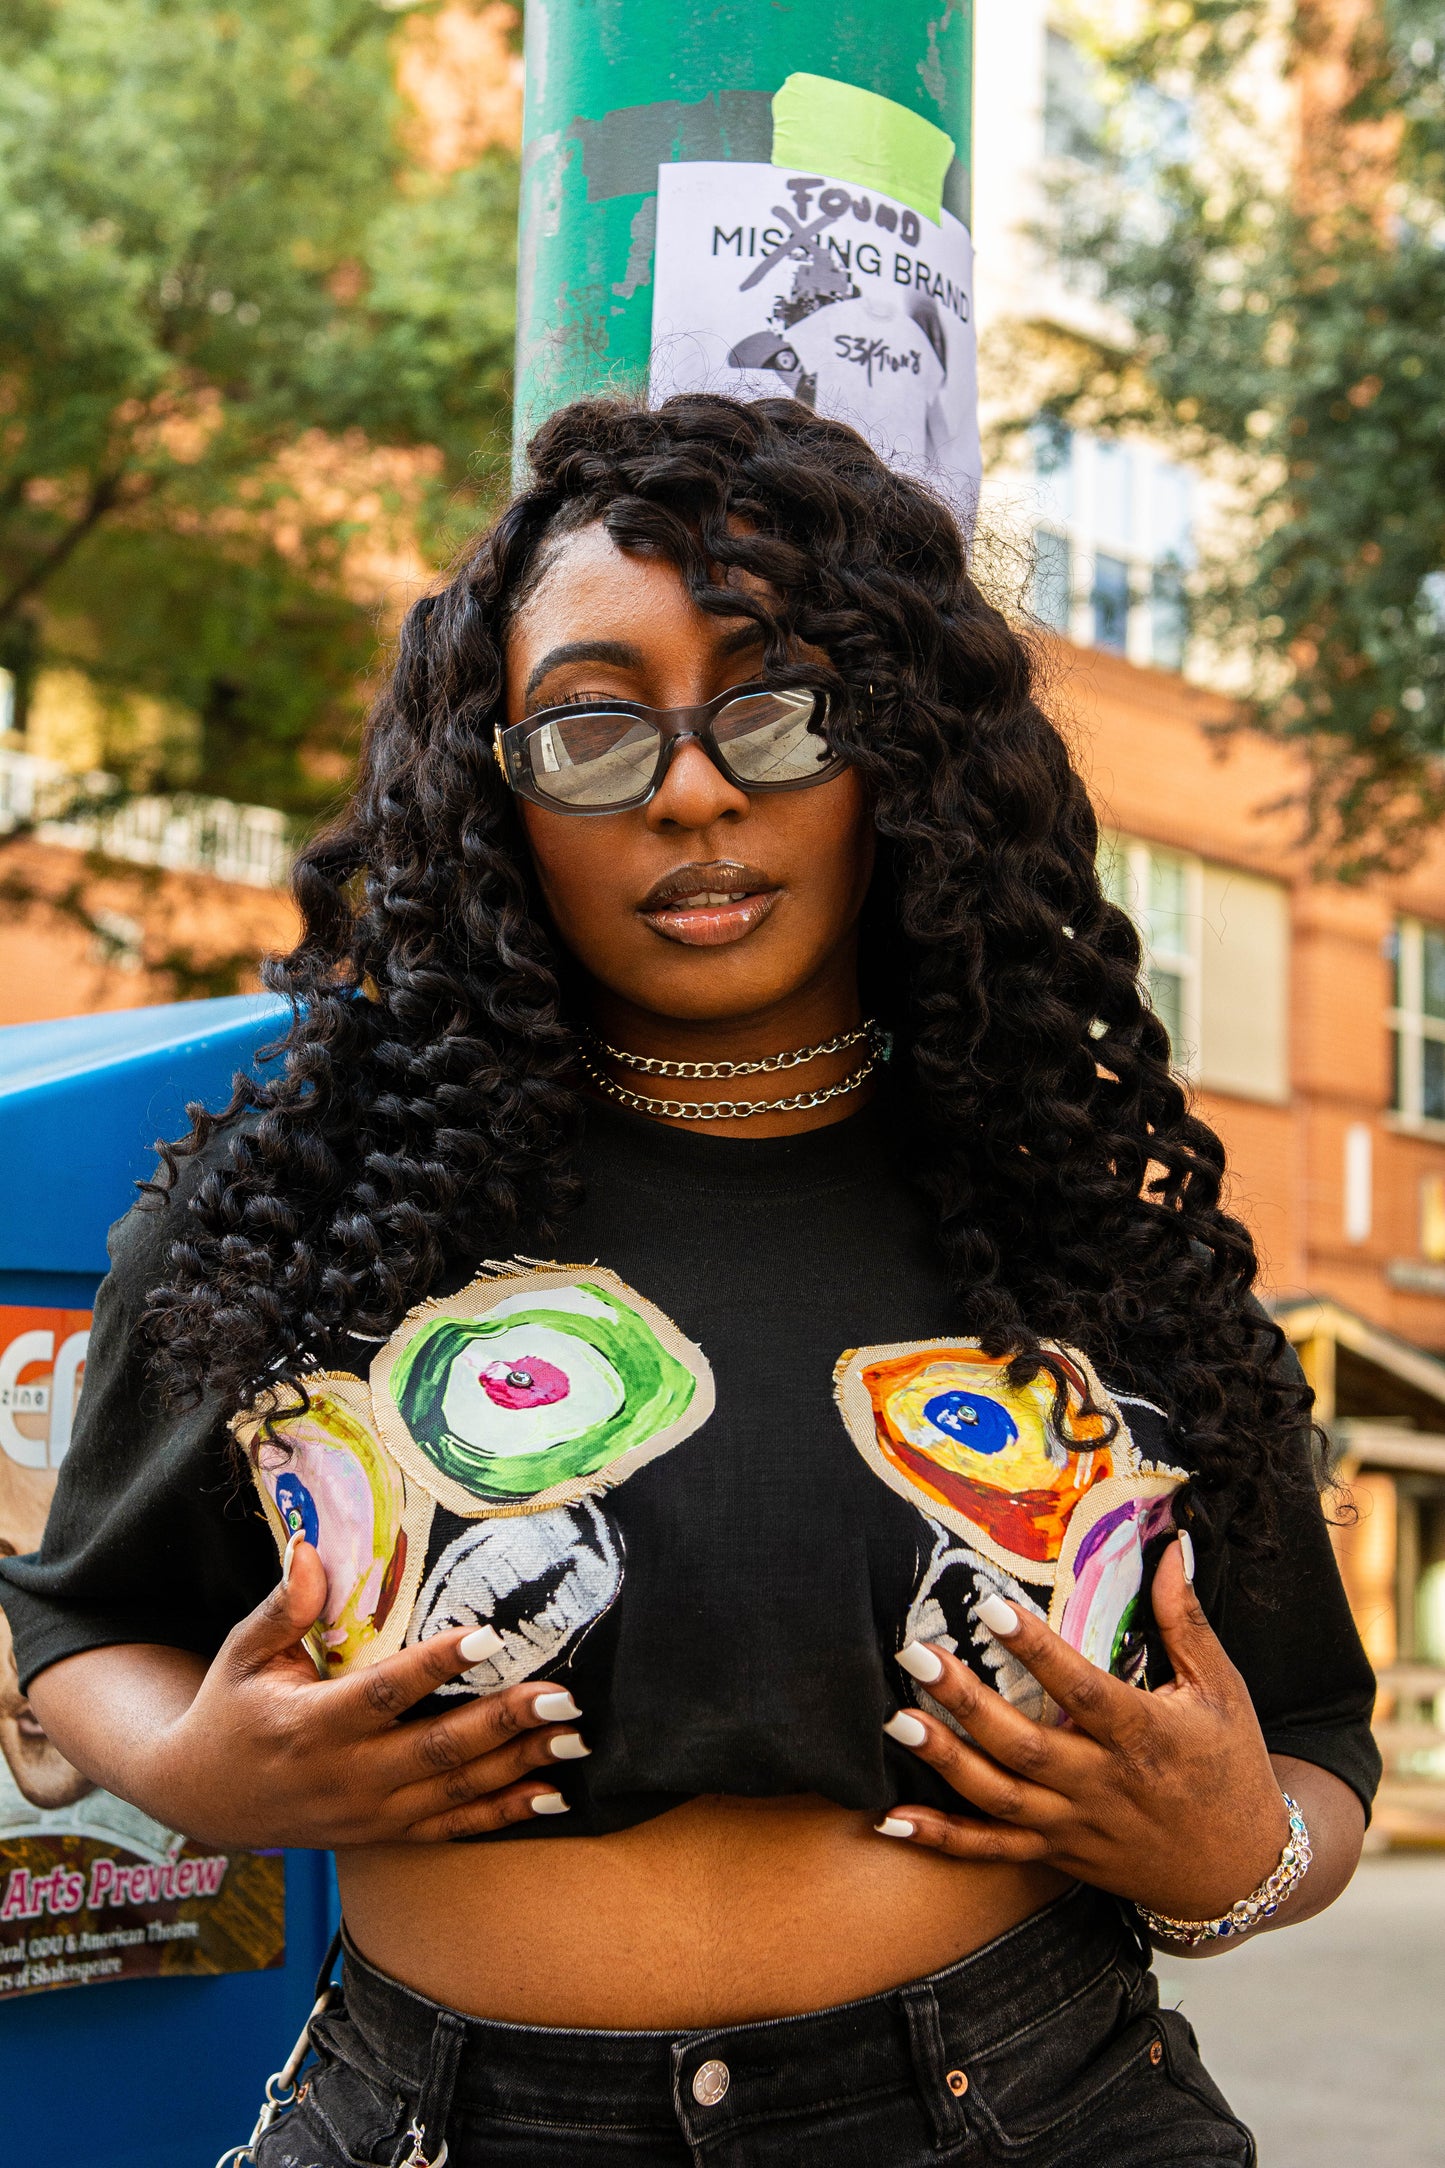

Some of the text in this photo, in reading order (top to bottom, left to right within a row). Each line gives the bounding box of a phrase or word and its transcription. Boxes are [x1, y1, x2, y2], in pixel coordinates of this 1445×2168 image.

[786, 177, 920, 248] FOUND
[894, 253, 969, 323] BRAND
[1, 1850, 228, 1921] Arts Preview
[14, 1963, 30, 1989] of
[30, 1957, 122, 1984] Shakespeare
[79, 1926, 146, 1953] American
